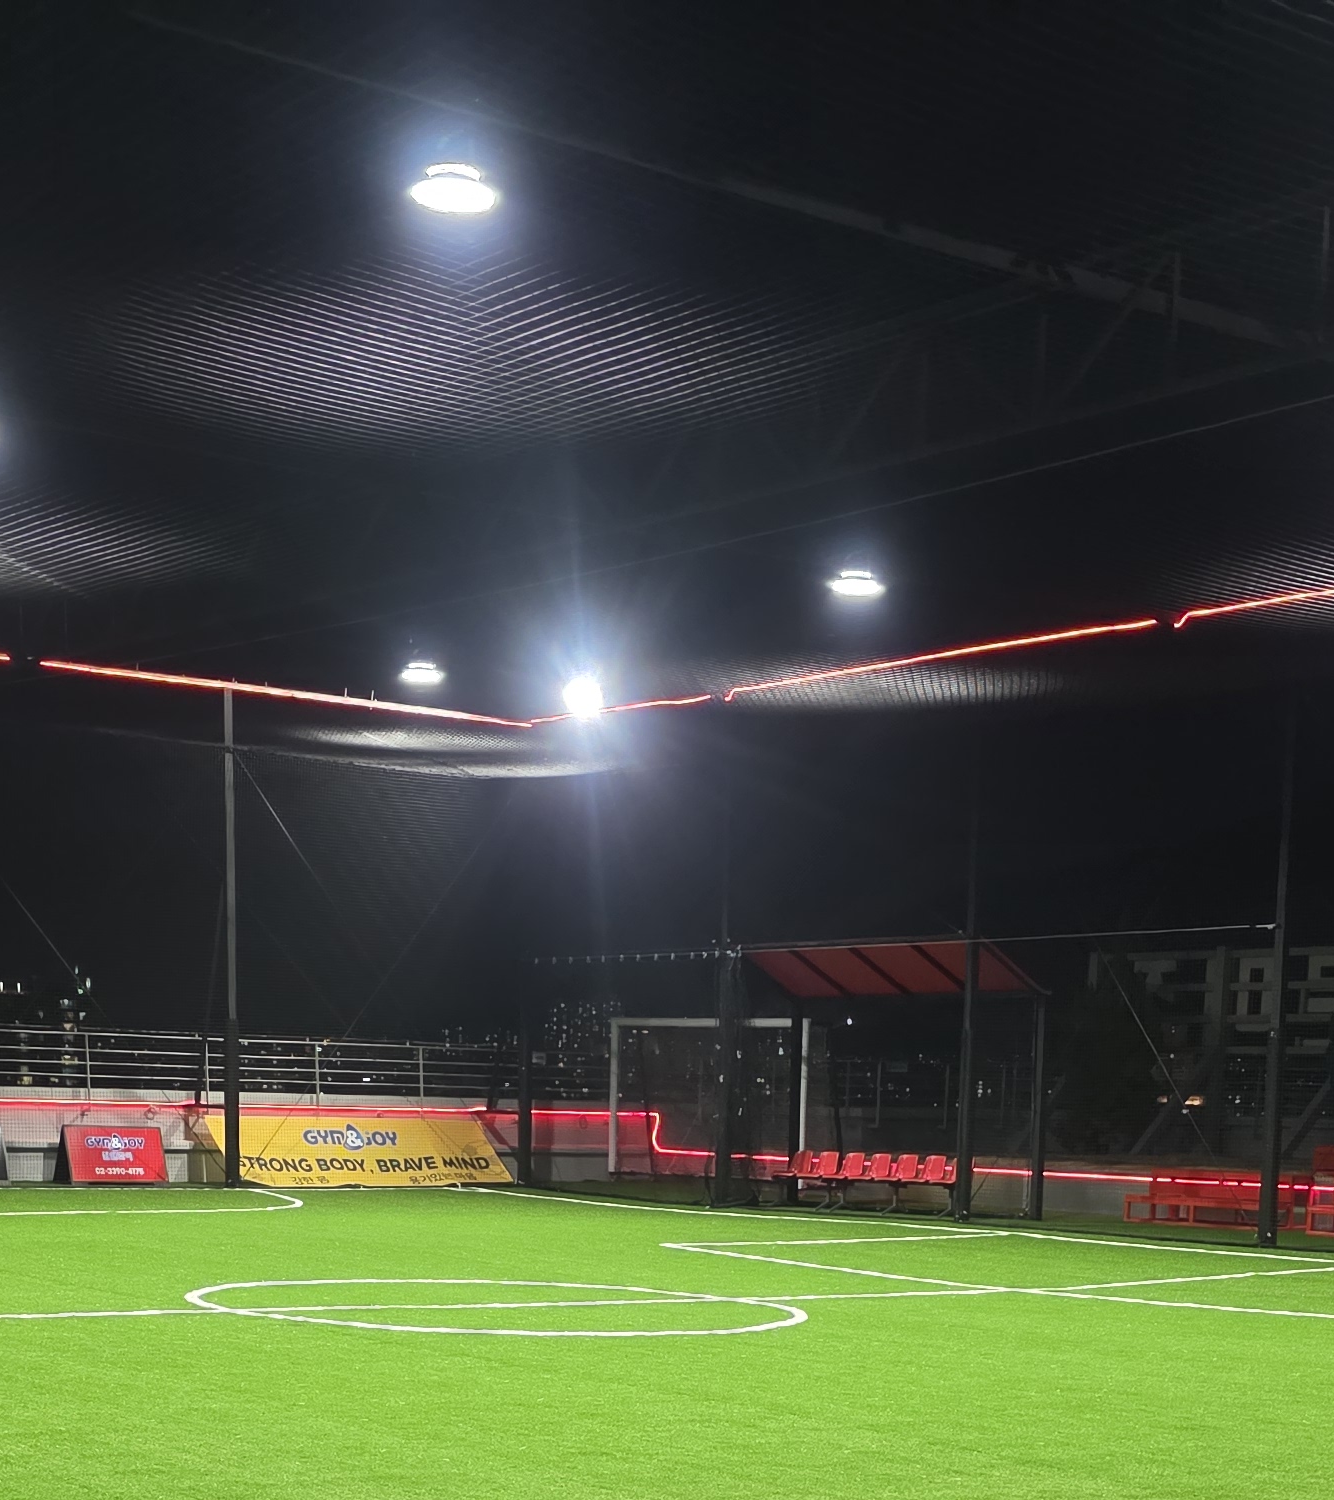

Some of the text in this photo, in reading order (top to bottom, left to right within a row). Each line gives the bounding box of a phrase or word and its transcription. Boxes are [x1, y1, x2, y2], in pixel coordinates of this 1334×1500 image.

[302, 1125, 398, 1147] GYM&JOY
[375, 1156, 438, 1173] BRAVE
[440, 1155, 490, 1171] MIND
